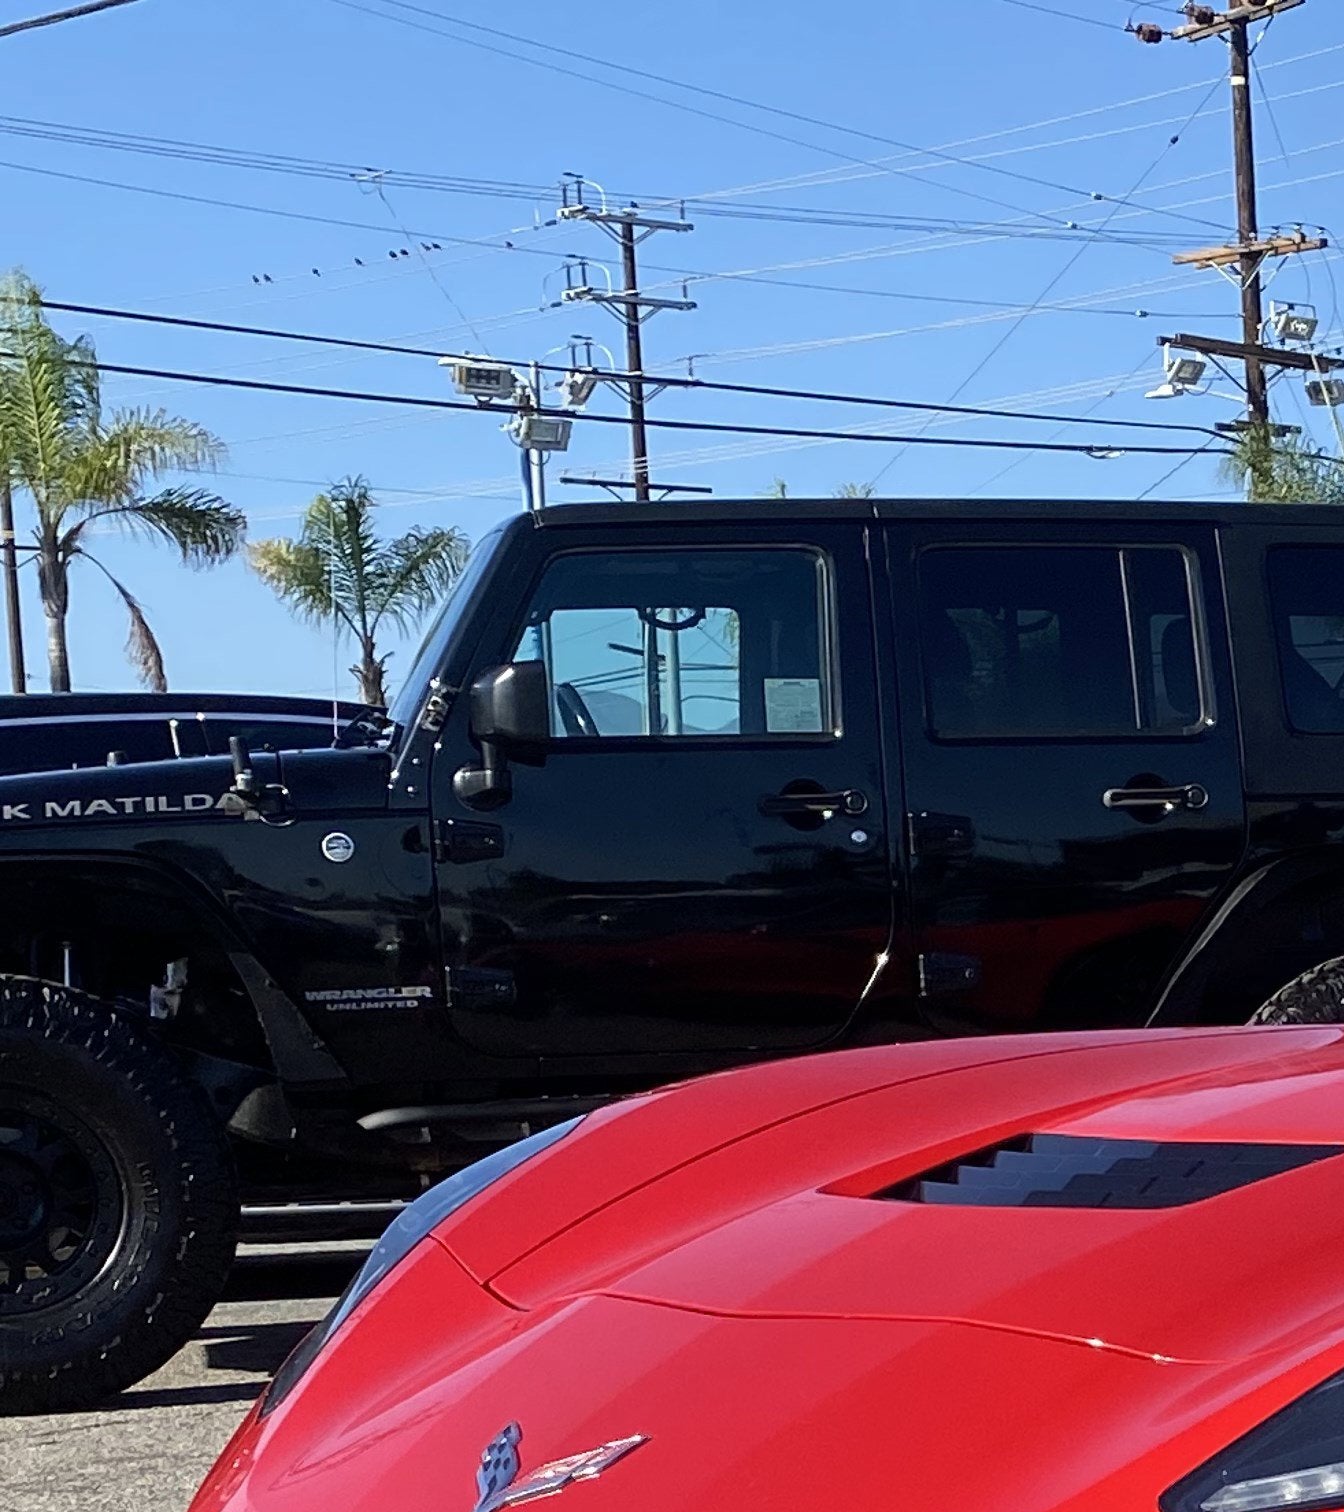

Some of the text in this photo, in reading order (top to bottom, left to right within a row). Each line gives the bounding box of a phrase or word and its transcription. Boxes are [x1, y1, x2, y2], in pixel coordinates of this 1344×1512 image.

[44, 792, 247, 818] MATILDA
[304, 986, 434, 1001] WRANGLER
[326, 999, 419, 1011] UNLIMITED
